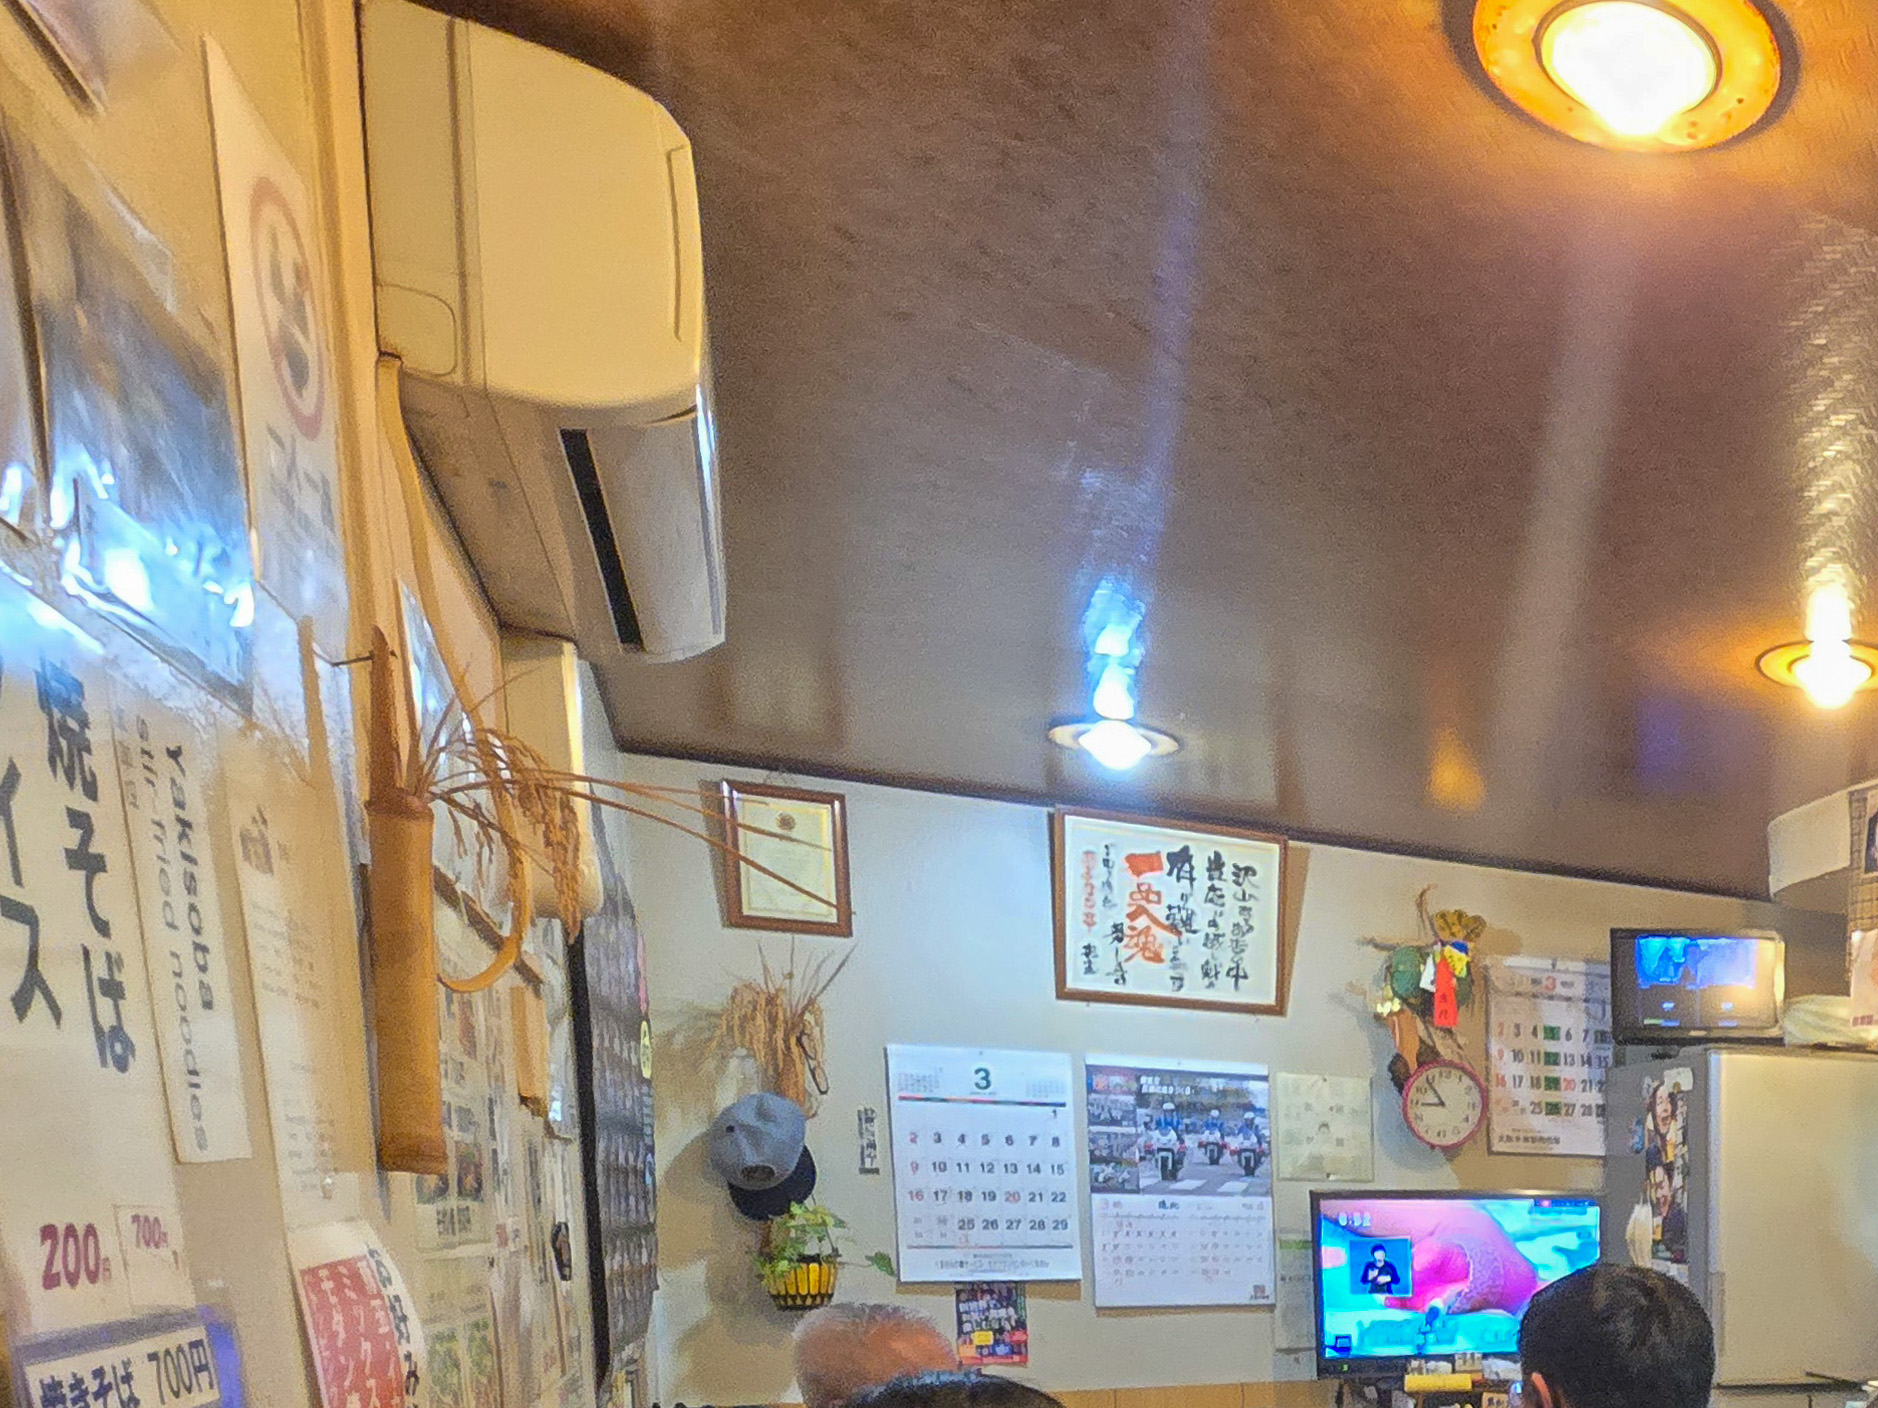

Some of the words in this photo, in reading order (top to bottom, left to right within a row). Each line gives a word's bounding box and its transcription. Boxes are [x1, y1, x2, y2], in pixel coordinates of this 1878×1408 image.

[1544, 975, 1557, 992] 3
[974, 1067, 992, 1090] 3
[909, 1131, 919, 1144] 2
[933, 1131, 942, 1144] 3
[957, 1133, 966, 1145] 4
[981, 1133, 990, 1146] 5
[1005, 1134, 1014, 1147] 6
[1028, 1134, 1038, 1147] 7
[1051, 1136, 1061, 1148] 8
[910, 1161, 919, 1174] 9
[932, 1161, 948, 1173] 10
[956, 1162, 971, 1173] 11
[980, 1162, 995, 1174] 12
[1003, 1163, 1019, 1175] 13
[1026, 1163, 1042, 1175] 14
[1050, 1164, 1065, 1176] 15
[908, 1190, 924, 1201] 16
[933, 1190, 948, 1202] 17
[957, 1190, 973, 1202] 18
[981, 1190, 997, 1202] 19
[1004, 1191, 1021, 1203] 20
[1028, 1191, 1044, 1203] 21
[1051, 1191, 1067, 1203] 22
[957, 1218, 976, 1231] 25
[981, 1218, 999, 1231] 26
[1005, 1219, 1022, 1231] 27
[1029, 1219, 1046, 1231] 28
[1052, 1219, 1069, 1231] 29
[146, 1338, 215, 1406] 700円
